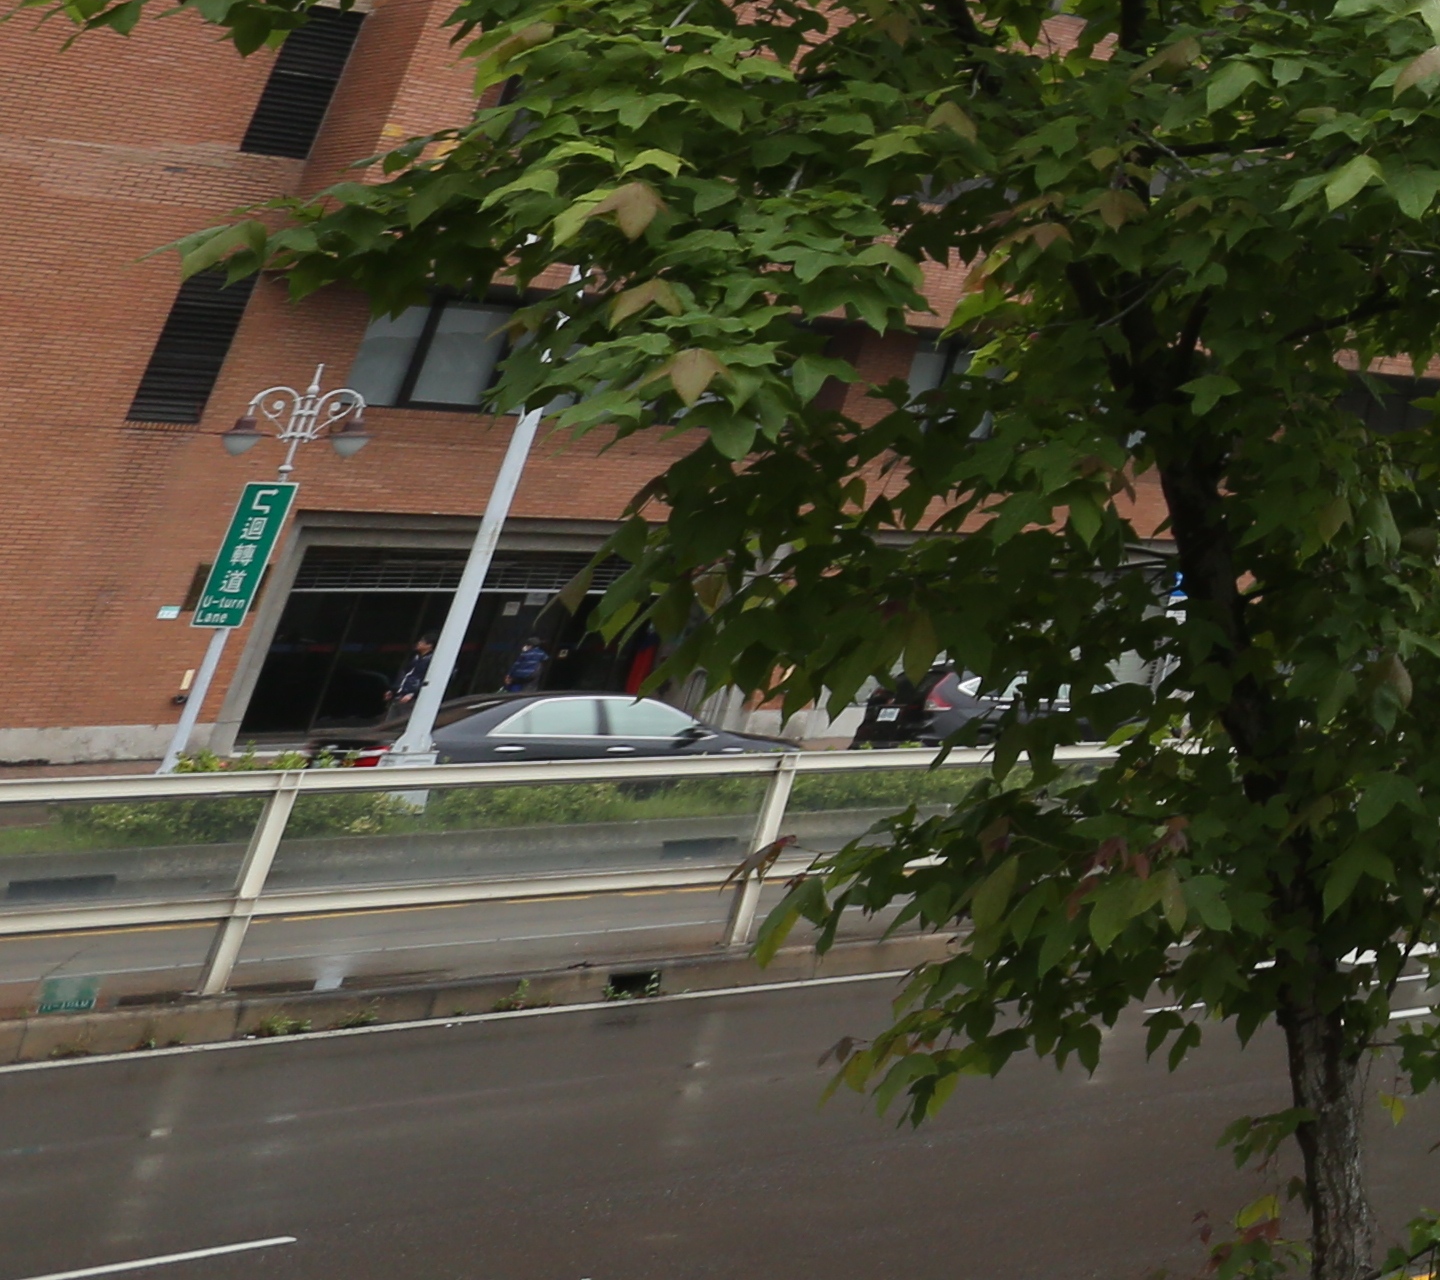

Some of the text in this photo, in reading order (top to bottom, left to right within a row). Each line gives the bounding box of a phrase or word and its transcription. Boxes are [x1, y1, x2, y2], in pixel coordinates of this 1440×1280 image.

[218, 516, 269, 594] 迴轉道
[202, 595, 246, 609] U-turn
[196, 610, 229, 624] Lane
